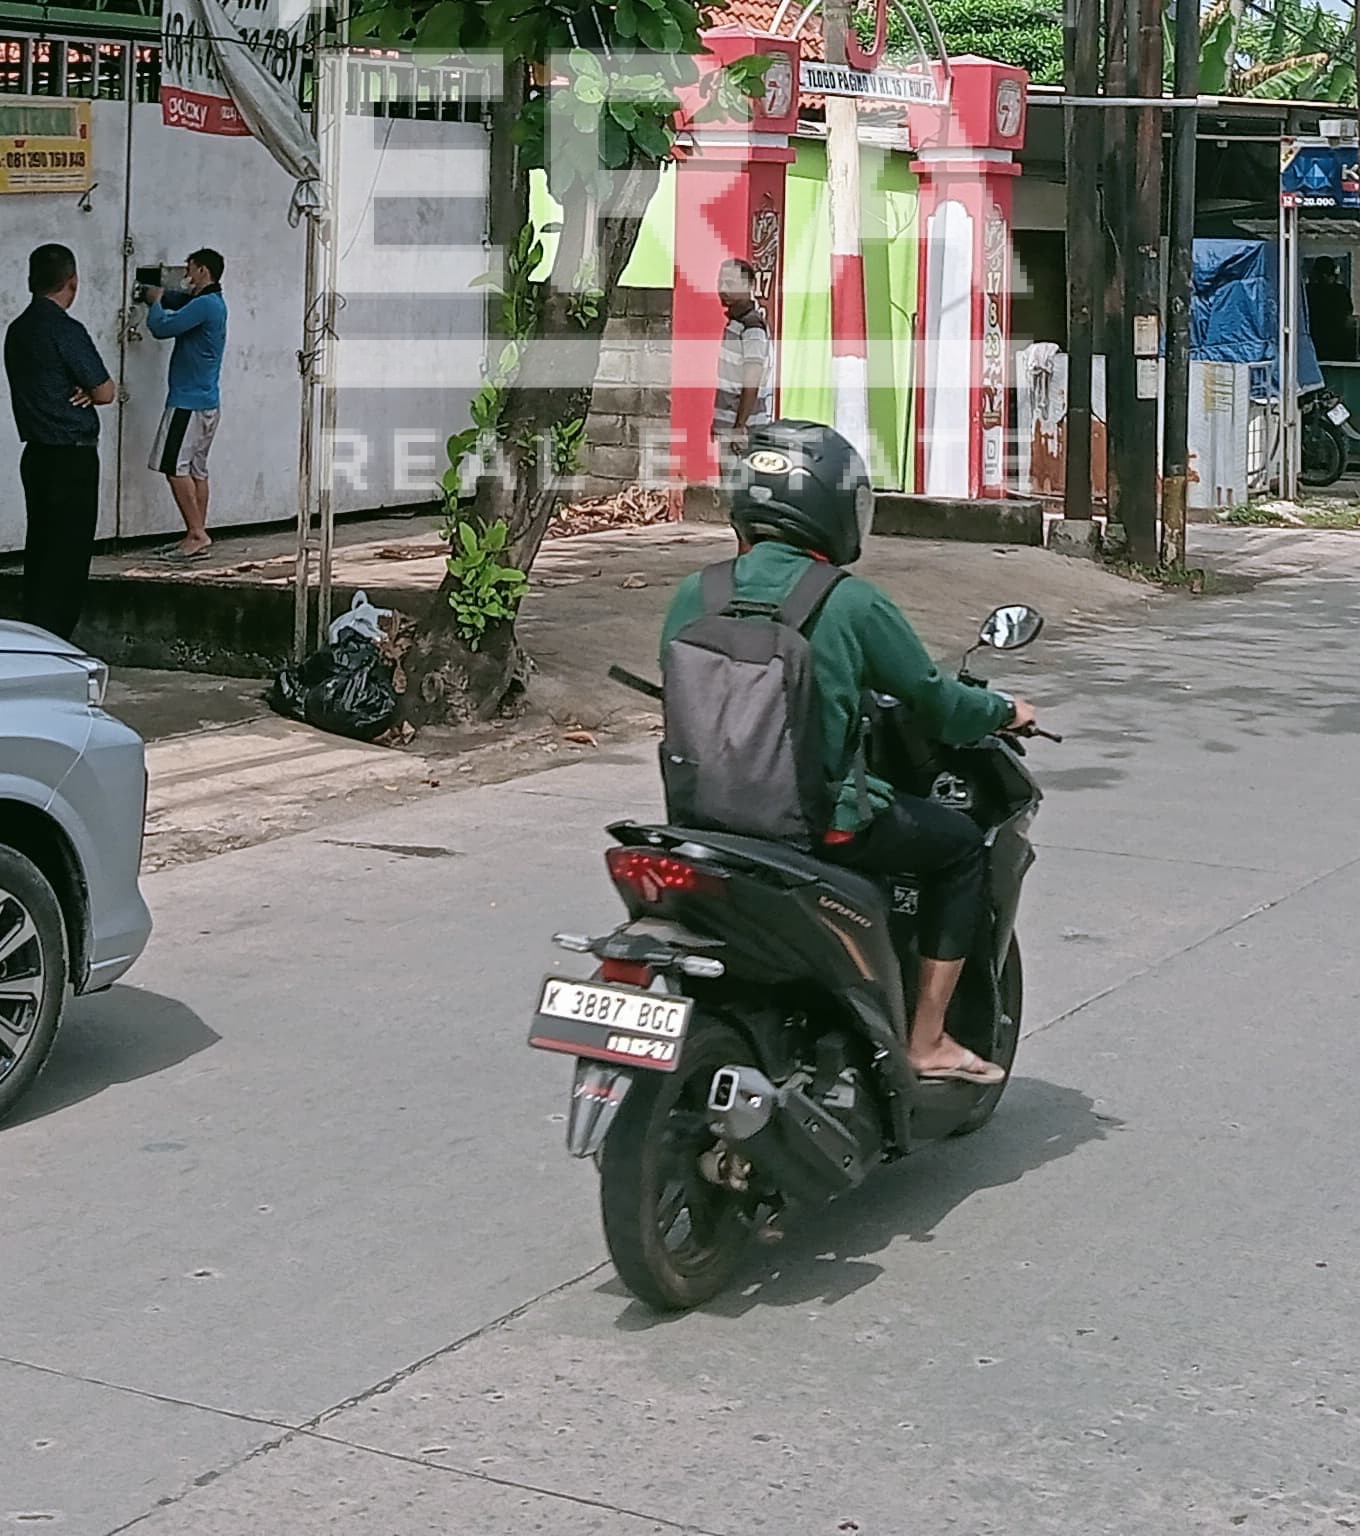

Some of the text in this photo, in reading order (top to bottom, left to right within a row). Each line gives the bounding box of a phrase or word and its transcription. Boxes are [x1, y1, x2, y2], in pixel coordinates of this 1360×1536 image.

[754, 271, 772, 298] 17
[987, 271, 1001, 295] 17
[989, 302, 997, 326] 8
[547, 987, 679, 1032] K 3887 BGC
